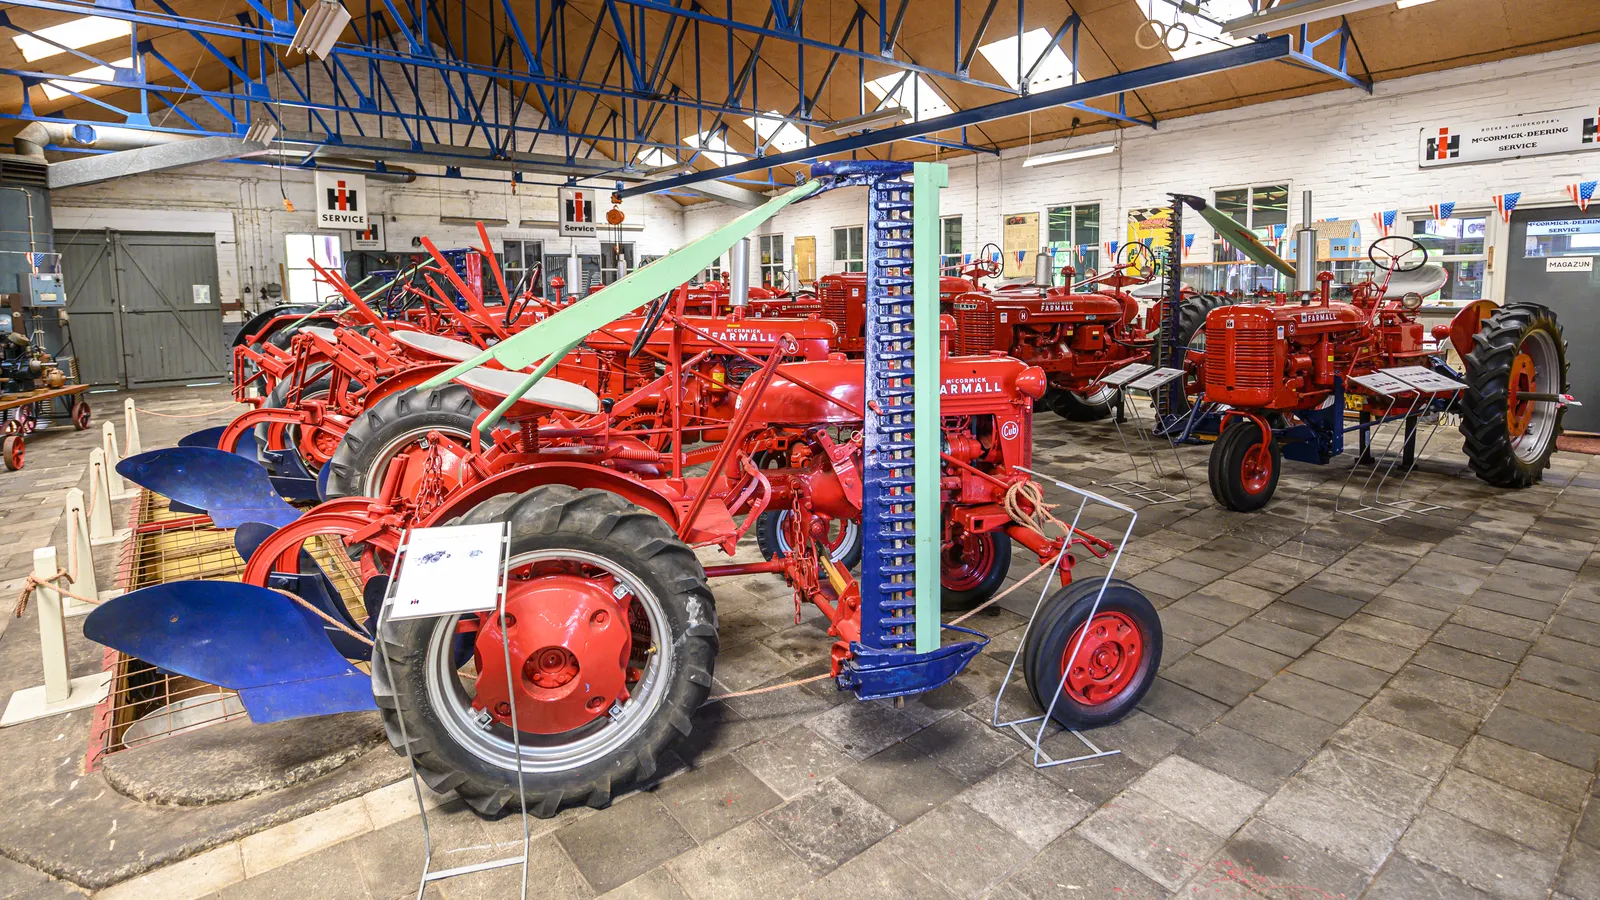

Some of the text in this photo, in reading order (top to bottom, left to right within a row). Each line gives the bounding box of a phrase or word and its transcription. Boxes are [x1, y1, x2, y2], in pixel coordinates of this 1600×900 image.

[1498, 142, 1538, 152] SERVICE
[322, 214, 364, 223] SERVICE
[564, 224, 595, 232] Service
[1021, 311, 1027, 320] H
[1308, 313, 1337, 322] FARMALL
[1289, 324, 1295, 333] C
[788, 342, 796, 351] A
[940, 382, 1002, 395] ARMALL
[1003, 424, 1017, 437] Cub
